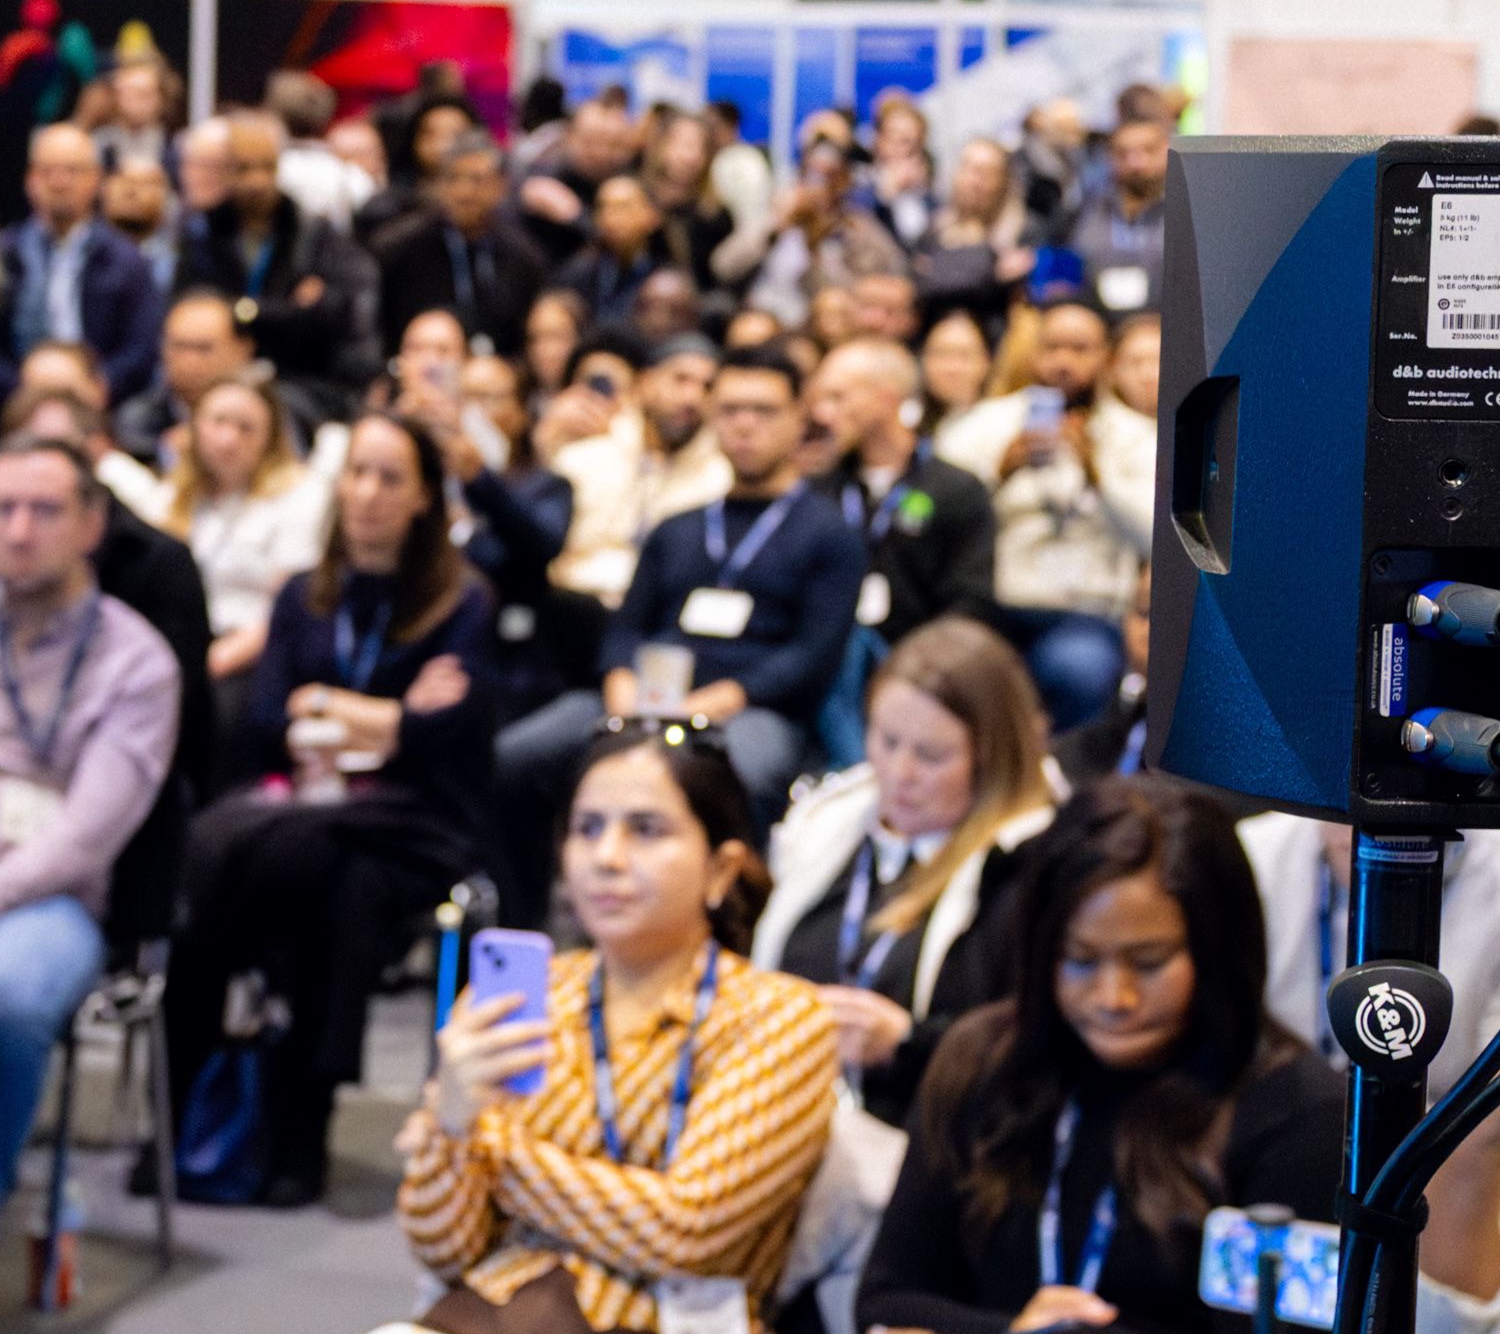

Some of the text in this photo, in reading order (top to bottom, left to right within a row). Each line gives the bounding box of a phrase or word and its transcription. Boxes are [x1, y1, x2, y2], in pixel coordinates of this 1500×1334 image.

[1436, 174, 1454, 182] Read
[1394, 206, 1419, 214] Model
[1394, 217, 1421, 226] Weight
[1446, 215, 1456, 223] kg
[1391, 274, 1426, 285] Amplifier
[1453, 274, 1468, 282] only
[1393, 365, 1423, 378] d&b
[1437, 391, 1470, 399] Germany
[1392, 637, 1404, 702] absolute
[1368, 982, 1413, 1060] K&M
